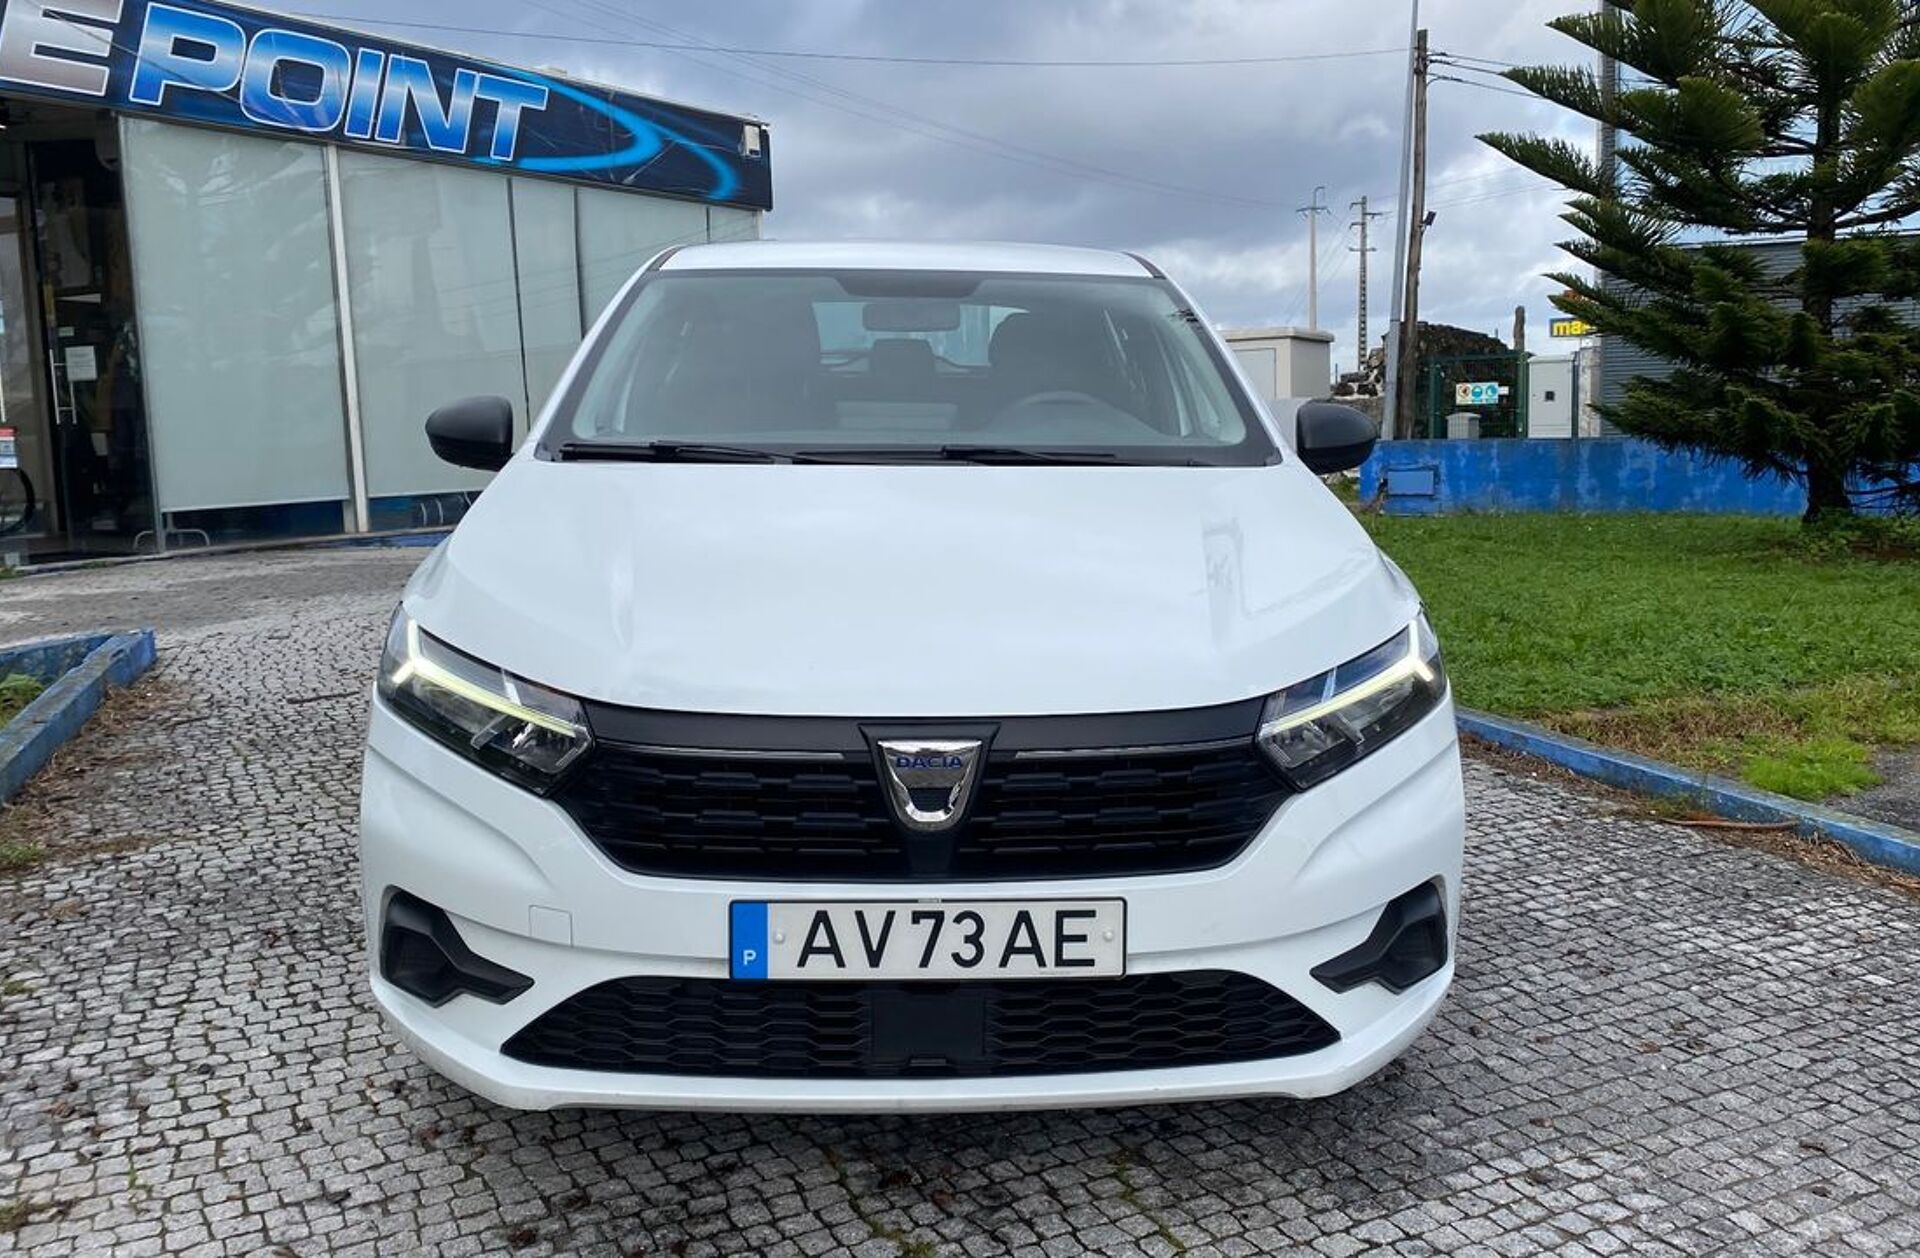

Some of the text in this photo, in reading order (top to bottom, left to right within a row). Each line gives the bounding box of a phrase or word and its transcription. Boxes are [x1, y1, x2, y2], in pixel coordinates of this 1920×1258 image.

[129, 2, 549, 161] POINT
[896, 756, 962, 768] DACIA
[743, 950, 757, 966] P
